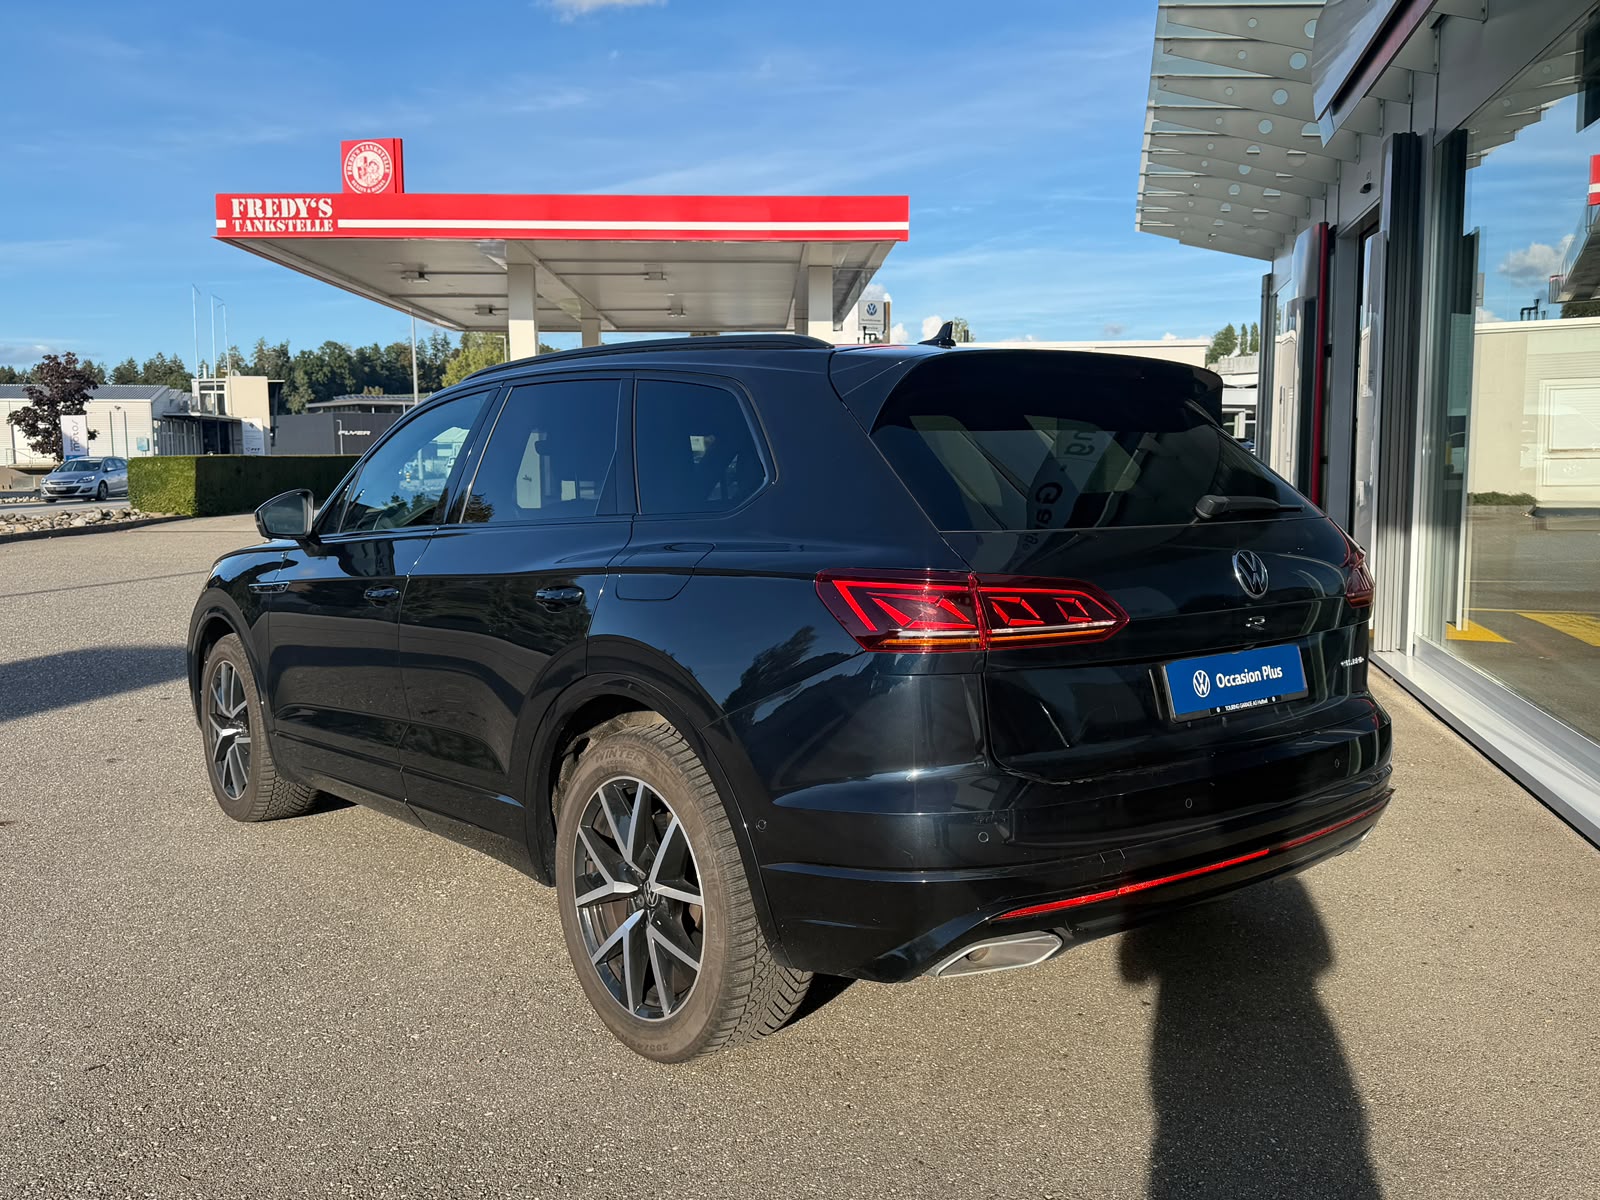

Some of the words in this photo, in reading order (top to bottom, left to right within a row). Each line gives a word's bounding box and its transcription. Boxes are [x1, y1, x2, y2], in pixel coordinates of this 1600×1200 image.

[231, 198, 333, 218] FREDY'S
[232, 219, 334, 232] TANKSTELLE
[1216, 669, 1261, 688] Occasion
[1261, 665, 1283, 680] Plus
